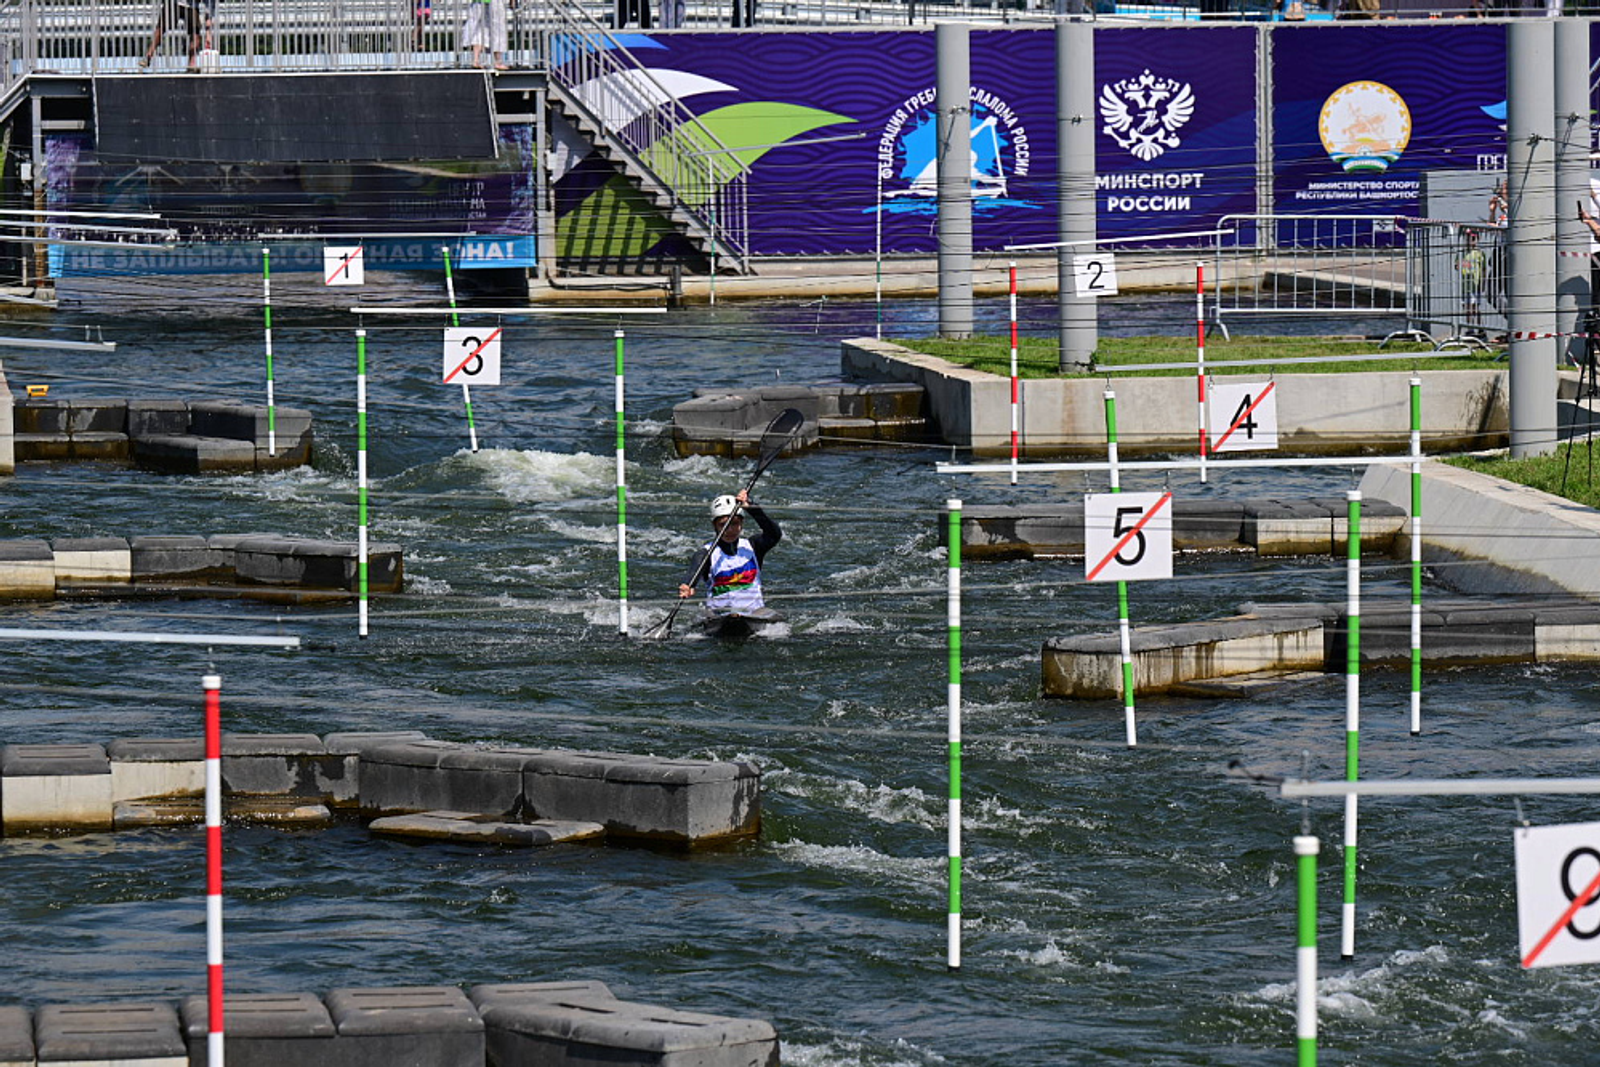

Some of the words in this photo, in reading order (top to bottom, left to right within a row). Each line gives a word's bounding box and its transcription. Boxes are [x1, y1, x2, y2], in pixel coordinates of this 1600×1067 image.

[878, 108, 908, 179] ФЕДЕРАЦИЯ
[969, 86, 1018, 128] СЛАЛОМА
[1010, 126, 1030, 176] РОССИИ
[1477, 154, 1507, 171] ГРЕ
[1095, 173, 1204, 190] МИНСПОРТ
[1308, 181, 1383, 190] МИНИСТЕРСТВО
[1108, 196, 1190, 212] РОССИИ
[1296, 191, 1358, 199] РЕСПУБЛИКИ
[1360, 190, 1419, 199] БАШКОРТОС
[72, 251, 104, 269] НЕ
[339, 253, 349, 279] 1
[1087, 261, 1105, 289] 2
[461, 336, 483, 375] 3
[1230, 394, 1257, 439] 4
[1113, 507, 1146, 566] 5
